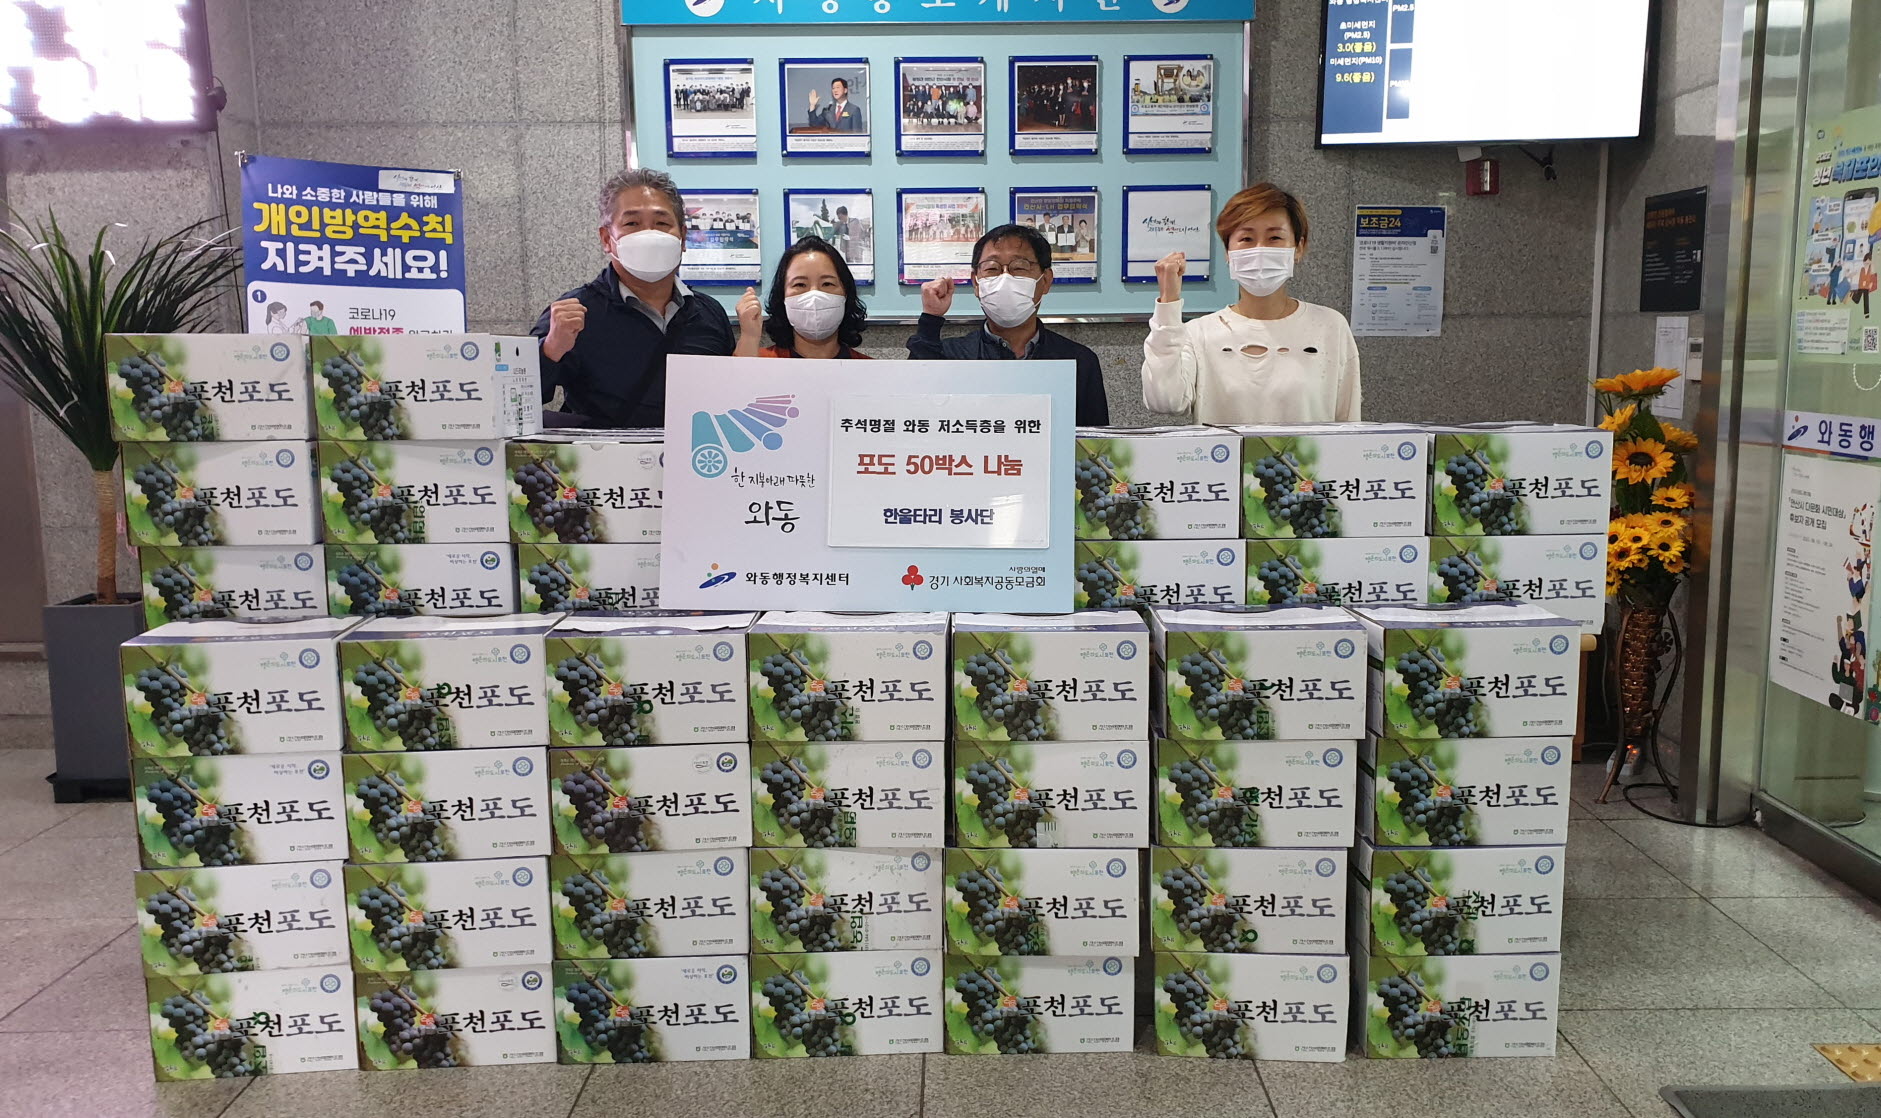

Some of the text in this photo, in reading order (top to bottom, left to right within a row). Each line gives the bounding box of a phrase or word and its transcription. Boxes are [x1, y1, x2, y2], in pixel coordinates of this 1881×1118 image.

[267, 184, 438, 209] 나와 소중한 사람들을 위해
[252, 202, 454, 244] 개인방역수칙
[1360, 217, 1402, 228] 보조금24
[260, 240, 448, 280] 지켜주세요!
[349, 306, 396, 322] 코로나19
[188, 379, 294, 403] 포천포도
[383, 379, 484, 403] 포천포도
[840, 418, 1041, 434] 추석명절 와동 저소득층을 위한
[1817, 420, 1876, 452] 와동행
[856, 454, 1023, 476] 포도 50박스 나눔
[730, 468, 744, 488] 한
[1315, 478, 1416, 502] 포천포도
[1504, 476, 1600, 500] 포천포도
[196, 485, 299, 508] 포천포도
[396, 483, 498, 508] 포천포도
[580, 486, 662, 509] 포천포
[1130, 480, 1230, 503] 포천포도
[744, 501, 800, 534] 와동
[883, 508, 995, 526] 한울타리 봉사단
[745, 572, 849, 586] 와동행정복지센터
[929, 574, 1046, 589] 경기 사회복지공동모금회
[1497, 580, 1595, 601] 포천포도
[216, 589, 318, 611] 포천포도
[402, 587, 504, 609] 포천포도
[1136, 584, 1236, 606] 포천포도
[1318, 582, 1418, 604] 포천포도
[423, 683, 536, 710] 포천포도
[626, 680, 736, 706] 포천포도
[828, 678, 934, 704] 포천포도
[1030, 678, 1138, 702] 포천포도
[1246, 677, 1355, 702] 포천포도
[1463, 674, 1568, 698] 포천포도
[210, 688, 325, 714] 포천포도
[631, 792, 740, 818] 포천포도
[828, 786, 934, 811] 포천포도
[1032, 787, 1138, 811] 포천포도
[1235, 786, 1344, 811] 포천포도
[1454, 784, 1559, 808] 포천포도
[221, 799, 335, 825] 포천포도
[425, 796, 538, 822] 포천포도
[628, 895, 736, 920] 포천포도
[826, 890, 932, 916] 포천포도
[1021, 894, 1128, 920] 포천포도
[1228, 894, 1336, 918] 포천포도
[1448, 893, 1552, 918] 포천포도
[222, 908, 336, 936] 포천포도
[426, 906, 538, 932] 포천포도
[632, 1002, 740, 1027] 포천포도
[828, 995, 932, 1020] 포천포도
[1019, 995, 1124, 1018] 포천포도
[1232, 999, 1338, 1024] 포천포도
[1444, 998, 1548, 1023] 포천포도
[232, 1013, 346, 1039] 포천포도
[437, 1010, 546, 1035] 포천포도
